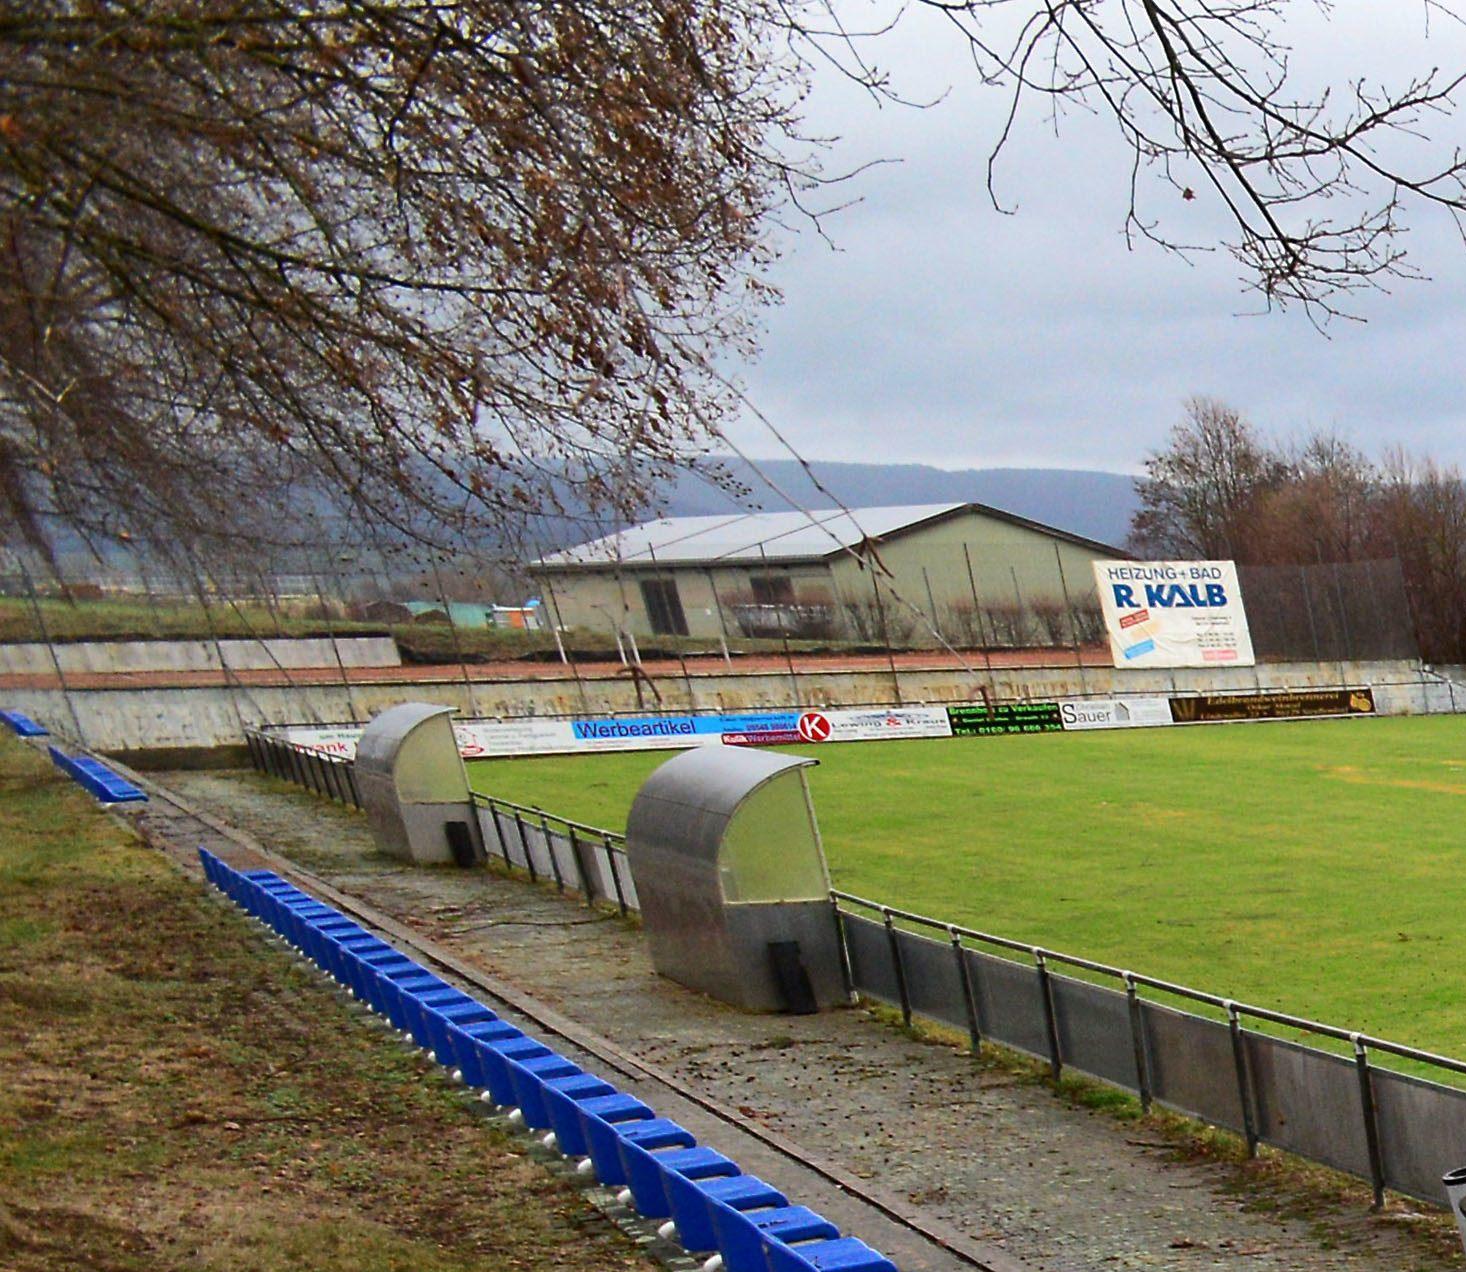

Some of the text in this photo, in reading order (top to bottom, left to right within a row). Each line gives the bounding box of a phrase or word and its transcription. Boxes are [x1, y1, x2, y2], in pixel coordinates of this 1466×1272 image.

[1108, 567, 1176, 580] HEIZUNG
[1189, 567, 1221, 580] BAD
[1144, 584, 1228, 608] KALB
[1063, 704, 1111, 724] Sauer
[576, 718, 697, 739] Werbeartikel
